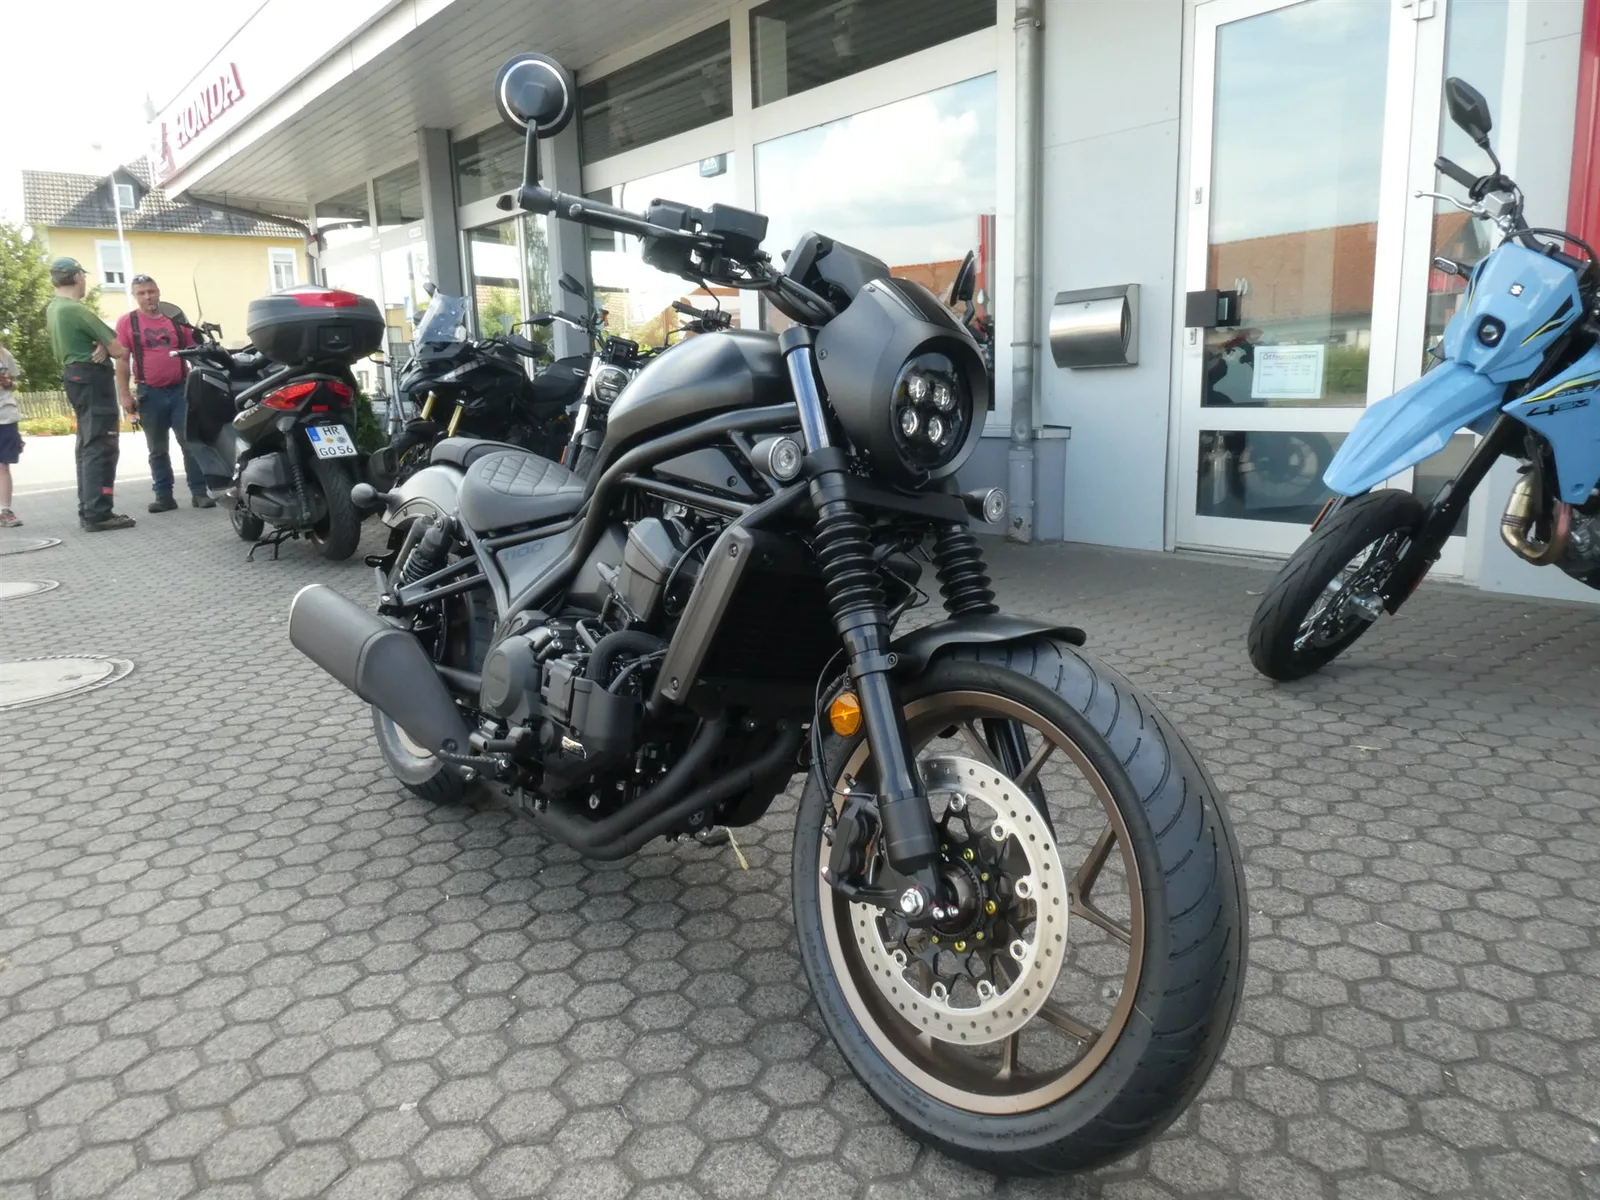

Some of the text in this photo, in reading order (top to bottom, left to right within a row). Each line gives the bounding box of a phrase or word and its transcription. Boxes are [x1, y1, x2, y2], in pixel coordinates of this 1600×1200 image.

[174, 62, 246, 150] HONDA
[322, 426, 341, 436] HR
[319, 445, 354, 457] GO 56
